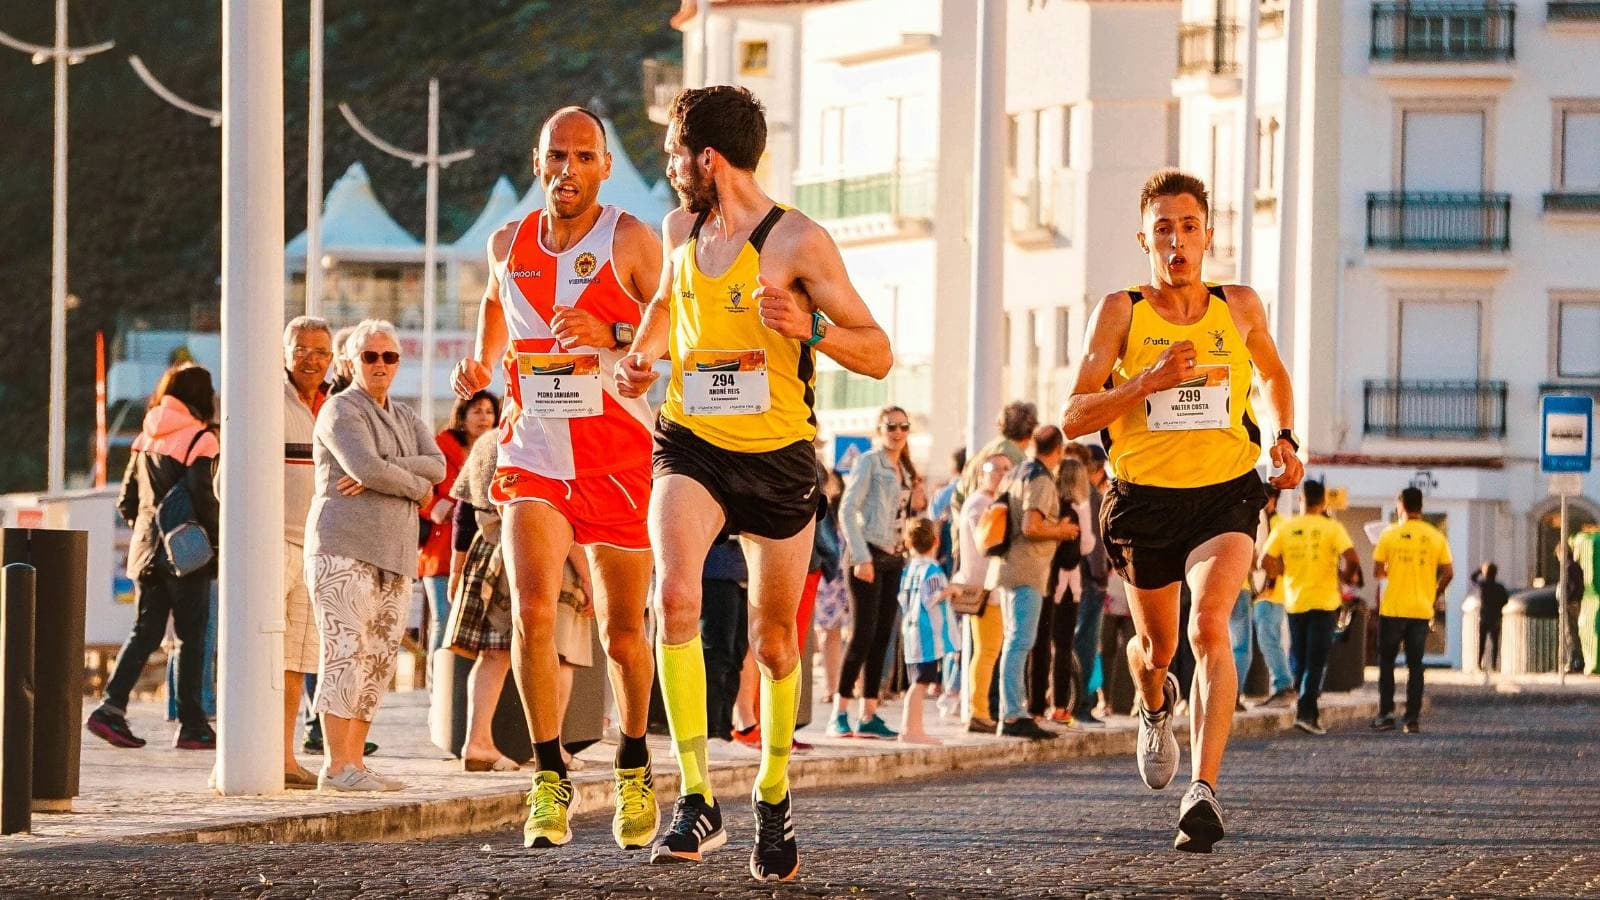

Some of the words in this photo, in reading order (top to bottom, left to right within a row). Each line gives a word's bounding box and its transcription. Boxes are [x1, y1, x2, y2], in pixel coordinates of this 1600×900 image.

[553, 377, 560, 390] 2
[712, 373, 735, 387] 294
[554, 390, 580, 398] JANUÁRIO
[709, 387, 726, 395] ANDRÉ
[1178, 389, 1201, 402] 299
